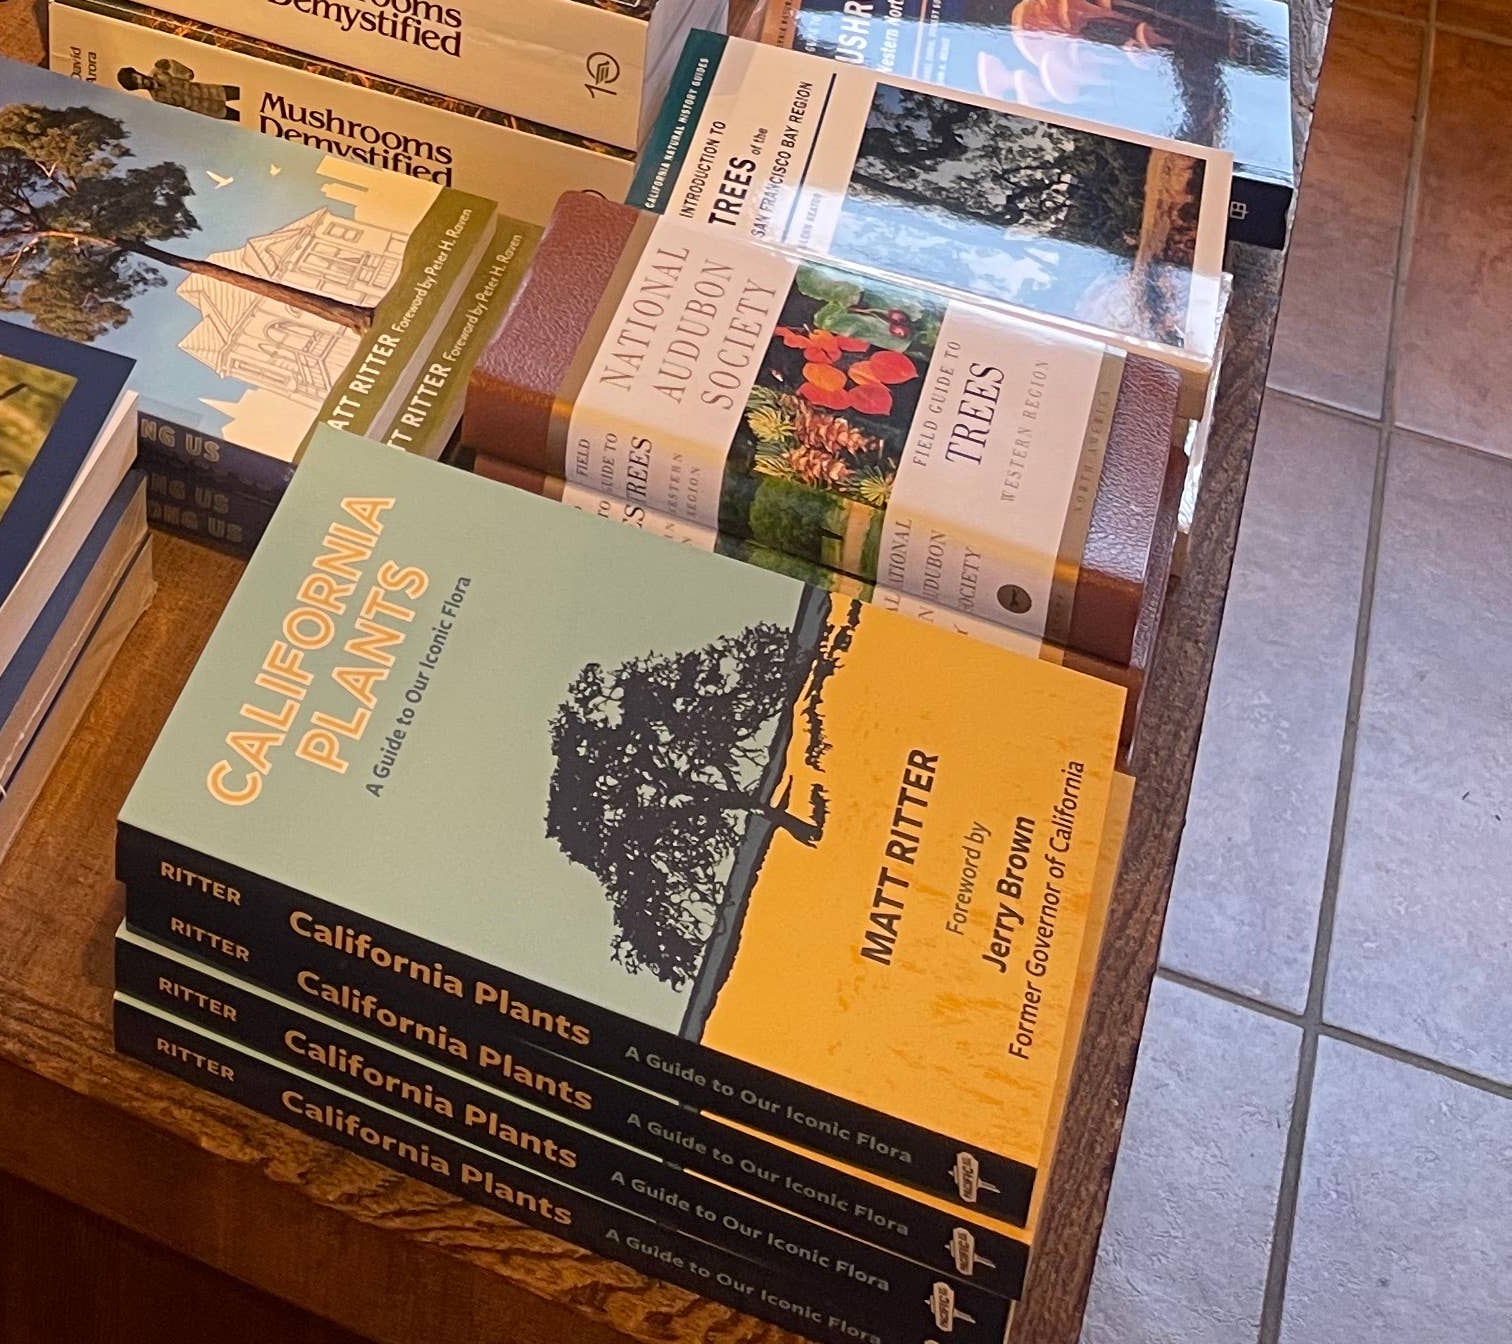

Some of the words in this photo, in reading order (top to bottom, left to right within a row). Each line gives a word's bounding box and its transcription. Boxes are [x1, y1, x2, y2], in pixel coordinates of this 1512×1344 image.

[680, 137, 720, 219] INTRODUCTION
[711, 120, 726, 138] TO
[752, 143, 761, 156] of
[756, 127, 768, 143] the
[449, 208, 472, 241] Raven
[708, 156, 757, 226] TREES
[422, 273, 436, 290] by
[426, 250, 449, 276] Peter
[442, 239, 455, 253] H.
[394, 284, 427, 333] Foreword
[600, 247, 690, 392] NATIONAL
[651, 258, 734, 405] AUDUBON
[700, 278, 777, 411] SOCIETY
[350, 332, 400, 393] RITTER
[206, 496, 397, 806] CALIFORNIA
[295, 560, 429, 774] PLANTS
[1049, 760, 1085, 853] California
[860, 866, 910, 967] MATT
[885, 749, 939, 865] RITTER
[945, 833, 983, 936] Foreword
[972, 821, 992, 845] by
[997, 816, 1036, 899] Brown
[1045, 854, 1066, 879] of
[160, 861, 242, 906] RITTER
[289, 911, 465, 999] California
[475, 981, 592, 1047] Plants
[982, 903, 1025, 974] Jerry
[1025, 881, 1062, 977] Governor
[1009, 980, 1043, 1060] Former
